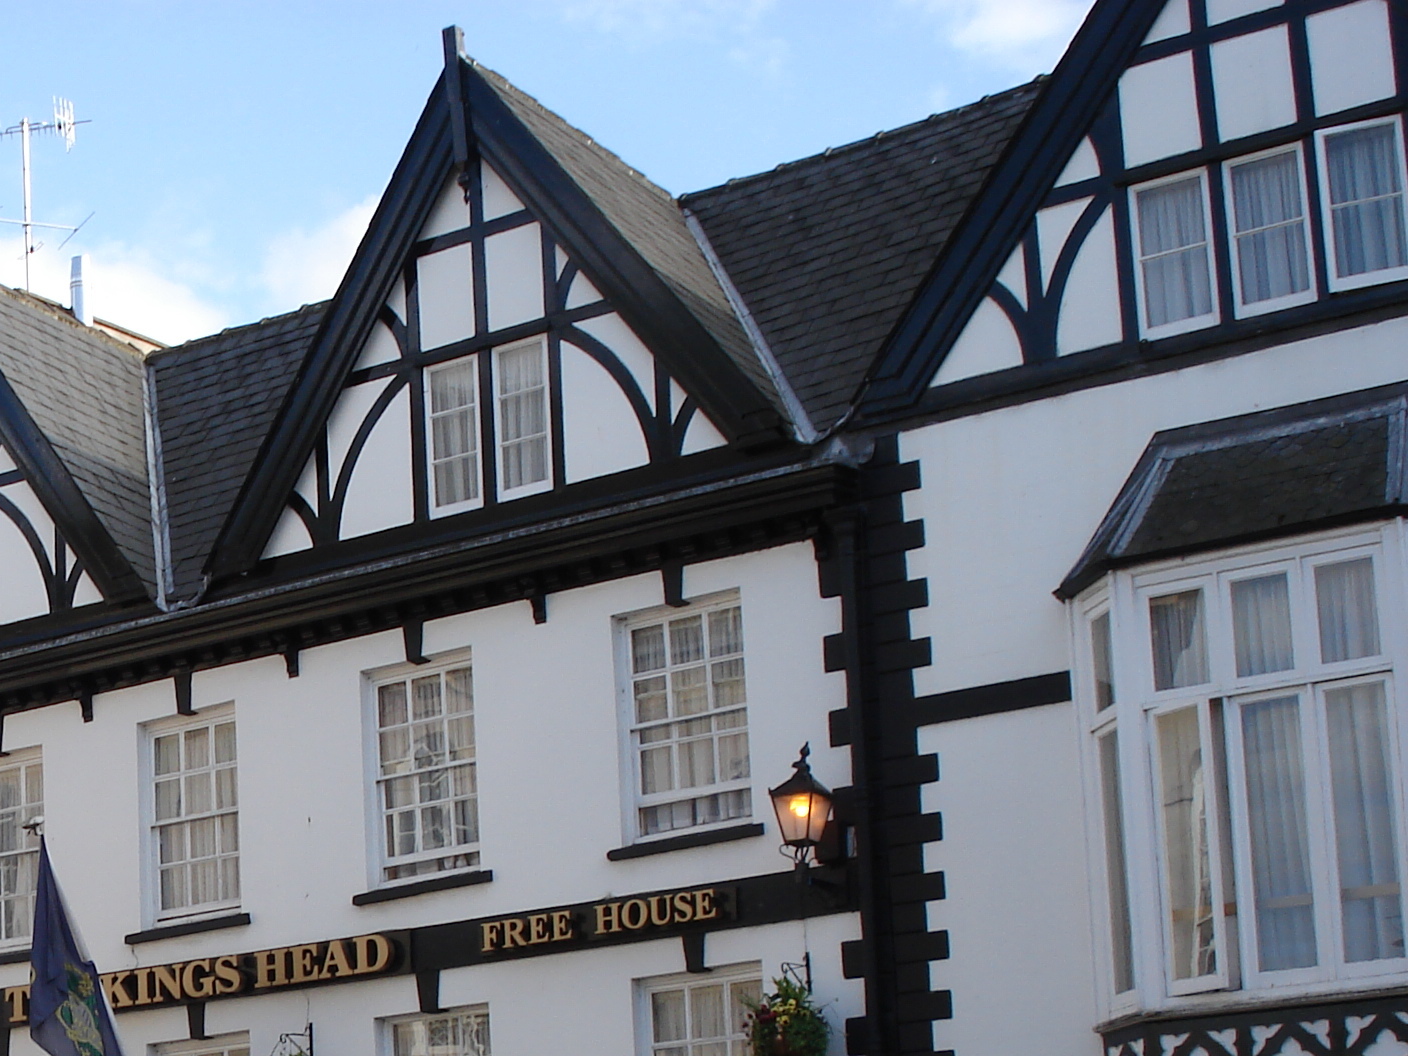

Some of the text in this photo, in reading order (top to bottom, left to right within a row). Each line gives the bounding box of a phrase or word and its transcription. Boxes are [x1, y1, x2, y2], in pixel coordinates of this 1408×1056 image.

[481, 888, 717, 952] FREE HOUSE
[100, 934, 392, 1008] KINGS HEAD
